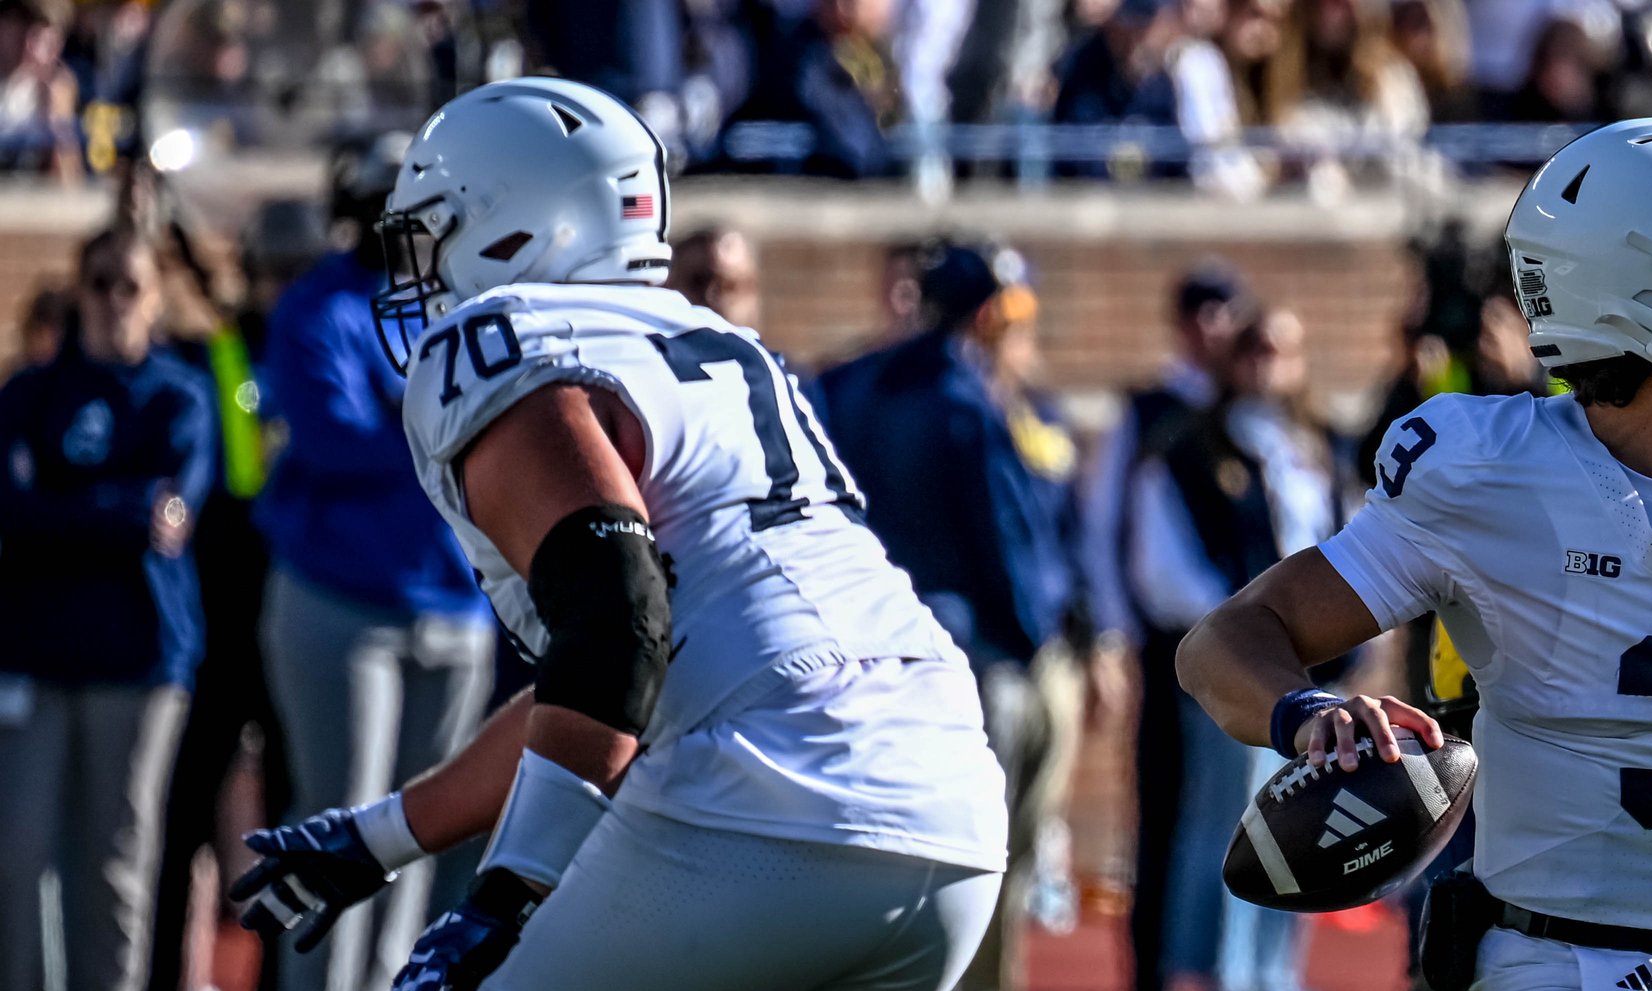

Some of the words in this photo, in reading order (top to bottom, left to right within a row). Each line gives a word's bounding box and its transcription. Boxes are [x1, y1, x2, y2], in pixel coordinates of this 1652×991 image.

[419, 313, 523, 409] 70
[1378, 416, 1438, 499] 3
[1343, 839, 1395, 876] DIME
